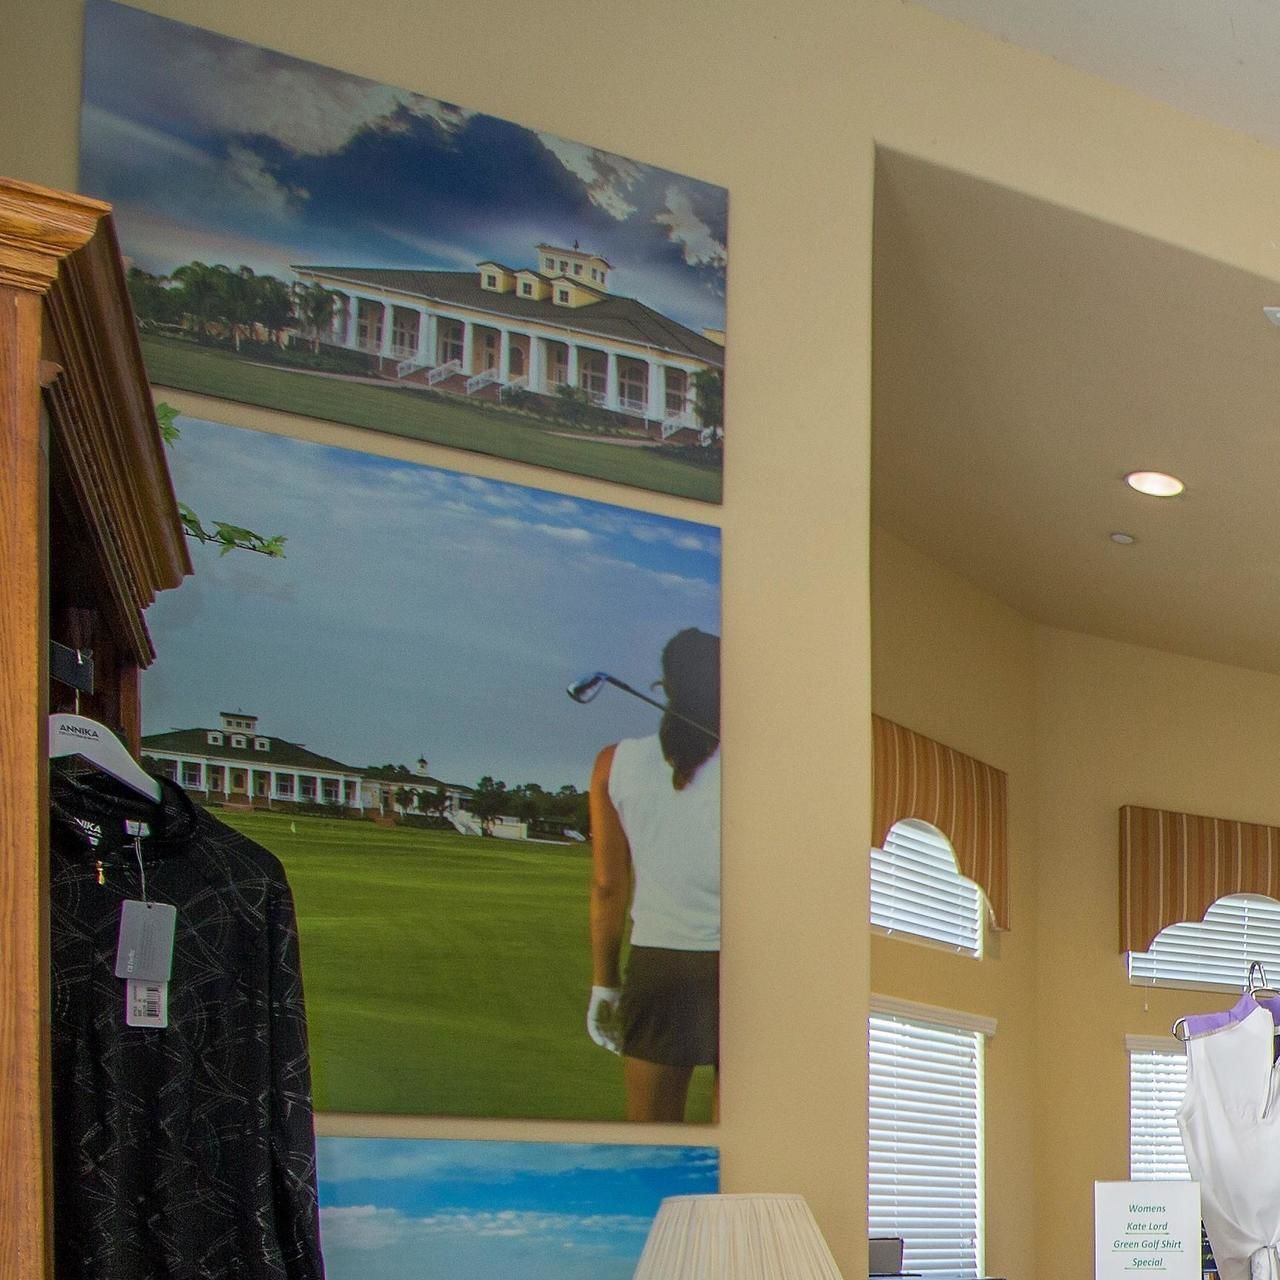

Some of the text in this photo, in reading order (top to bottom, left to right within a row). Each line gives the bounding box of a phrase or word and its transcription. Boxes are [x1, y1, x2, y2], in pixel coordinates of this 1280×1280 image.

[60, 724, 99, 738] ANNIKA
[1129, 1204, 1166, 1213] Womens
[1126, 1222, 1168, 1231] Kate Lord
[1113, 1240, 1182, 1251] Green Golf Shirt
[1132, 1258, 1163, 1268] Special
